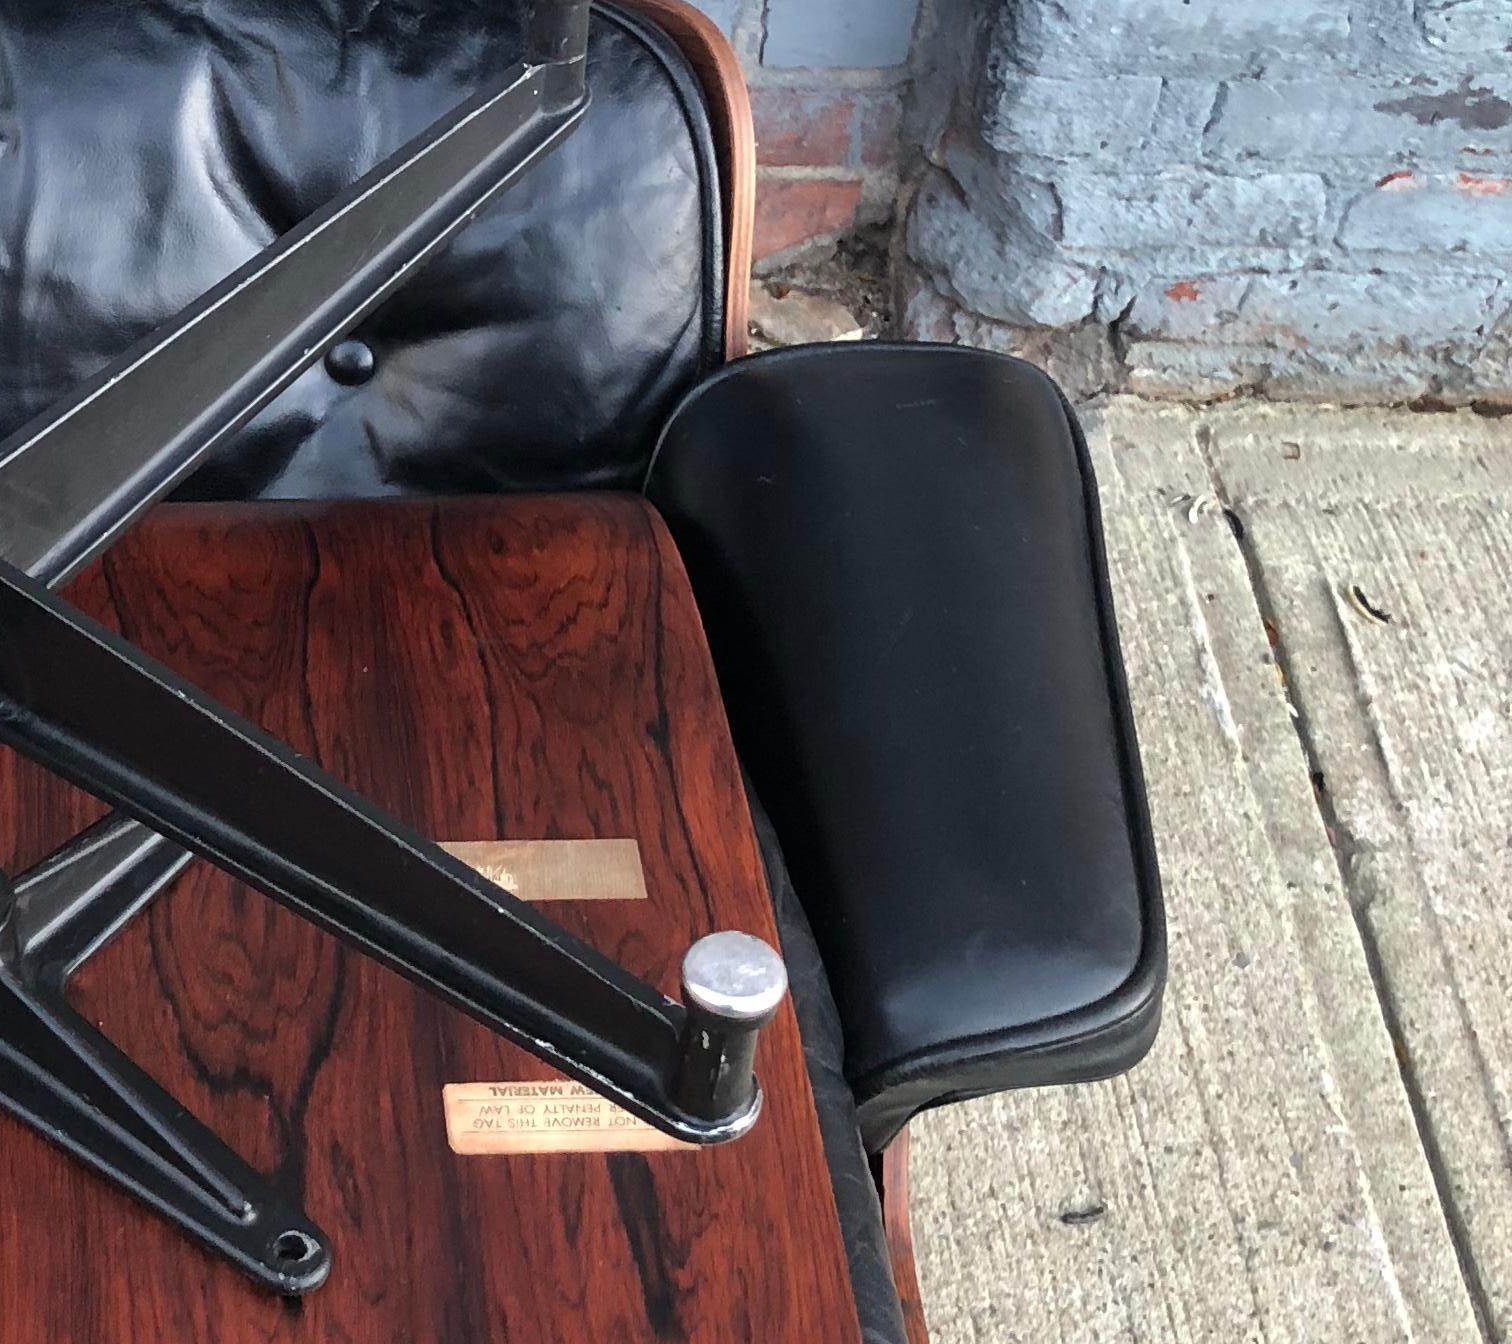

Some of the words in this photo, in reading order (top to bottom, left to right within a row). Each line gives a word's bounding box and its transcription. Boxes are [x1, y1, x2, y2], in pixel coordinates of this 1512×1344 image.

[489, 1086, 563, 1097] MATERIAL
[570, 1086, 595, 1096] EW
[479, 1105, 511, 1115] LAW
[519, 1104, 536, 1114] OF
[543, 1104, 601, 1114] PENALTY
[472, 1118, 502, 1128] TAG
[508, 1118, 537, 1128] THIS
[543, 1117, 600, 1127] REMOVE
